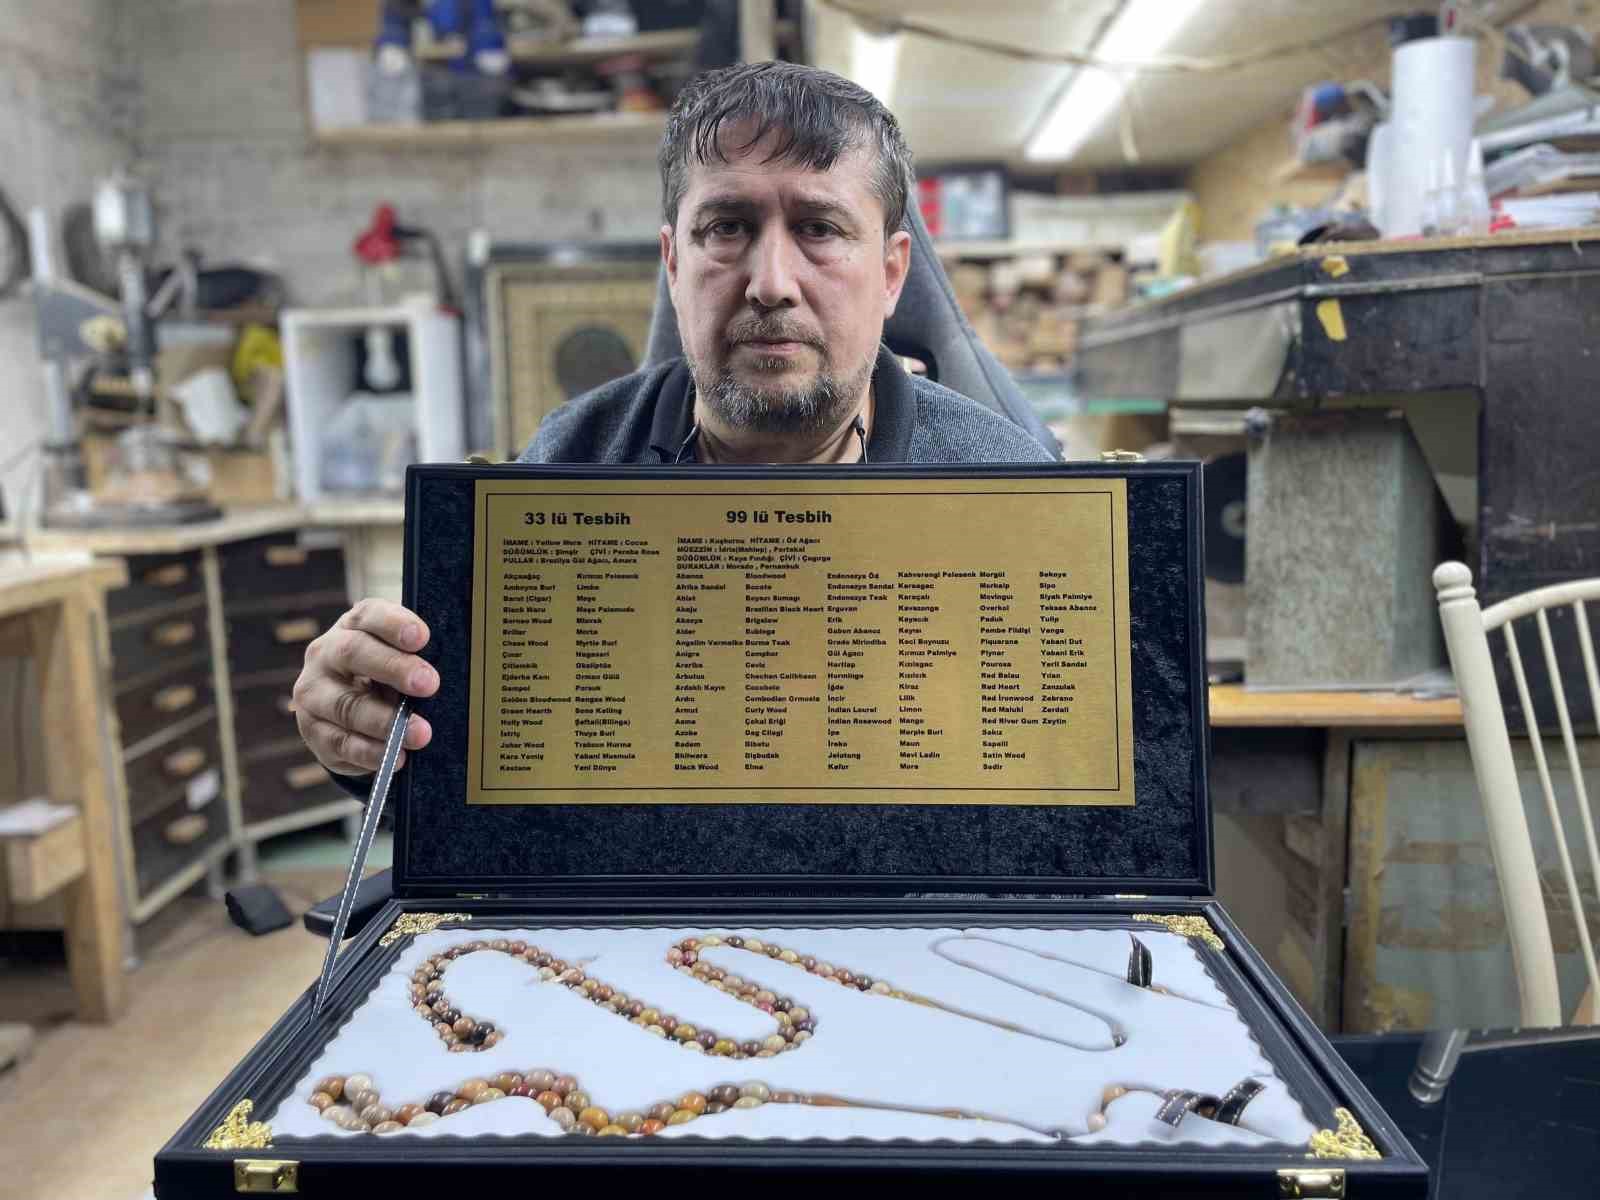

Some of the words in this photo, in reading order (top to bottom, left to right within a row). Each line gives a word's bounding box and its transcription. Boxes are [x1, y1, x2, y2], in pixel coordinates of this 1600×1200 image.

[524, 512, 546, 525] 33
[552, 512, 567, 525] lü
[572, 512, 630, 525] Tesbih
[726, 510, 747, 524] 99
[754, 510, 768, 523] lü
[774, 510, 832, 523] Tesbih
[1040, 582, 1056, 590] Sipo
[1040, 616, 1059, 624] Tulip
[899, 705, 922, 713] Limon
[1042, 718, 1066, 726] Zeytin
